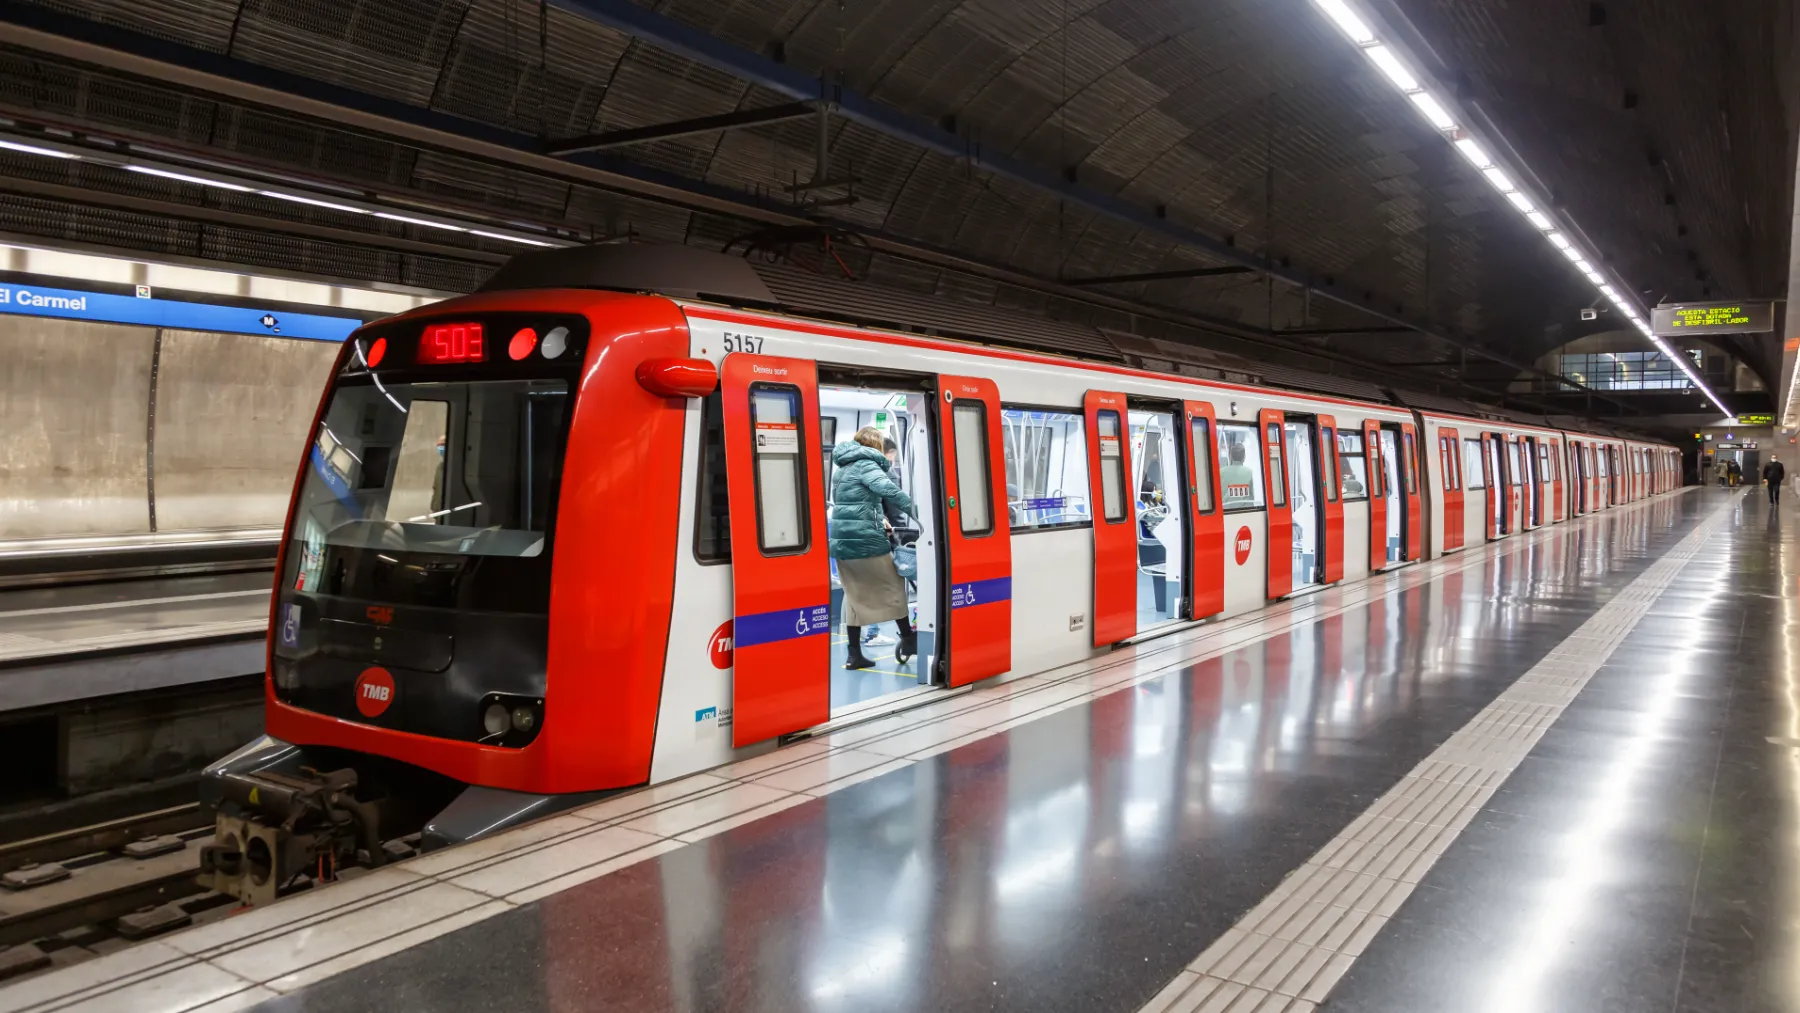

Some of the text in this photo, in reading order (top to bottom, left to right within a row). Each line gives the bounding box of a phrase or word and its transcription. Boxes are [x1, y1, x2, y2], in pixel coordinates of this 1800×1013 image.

[16, 290, 87, 311] Carmel
[263, 316, 274, 326] M
[435, 326, 483, 360] 503
[723, 331, 764, 354] 5157
[1237, 538, 1251, 552] TMB
[717, 637, 733, 653] TM
[363, 683, 390, 701] TMB
